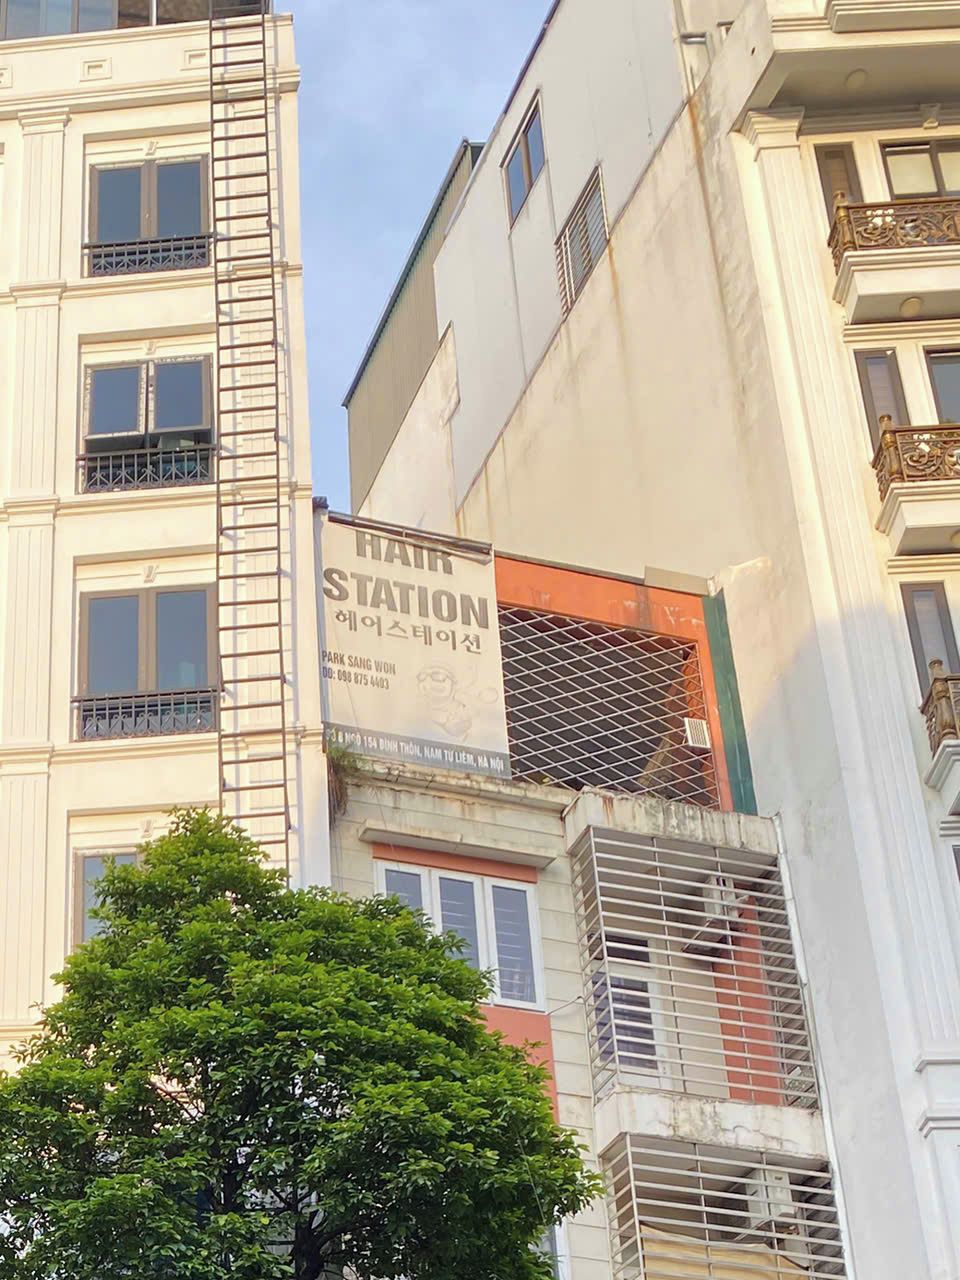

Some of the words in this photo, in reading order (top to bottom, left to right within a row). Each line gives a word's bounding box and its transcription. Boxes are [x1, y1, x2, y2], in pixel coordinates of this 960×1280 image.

[355, 530, 453, 575] HAIR
[322, 567, 489, 629] STATION
[335, 609, 482, 655] 헤어스테이션
[321, 650, 345, 666] PARK
[347, 655, 372, 671] SANG
[374, 660, 396, 675] WON
[353, 672, 368, 686] 875
